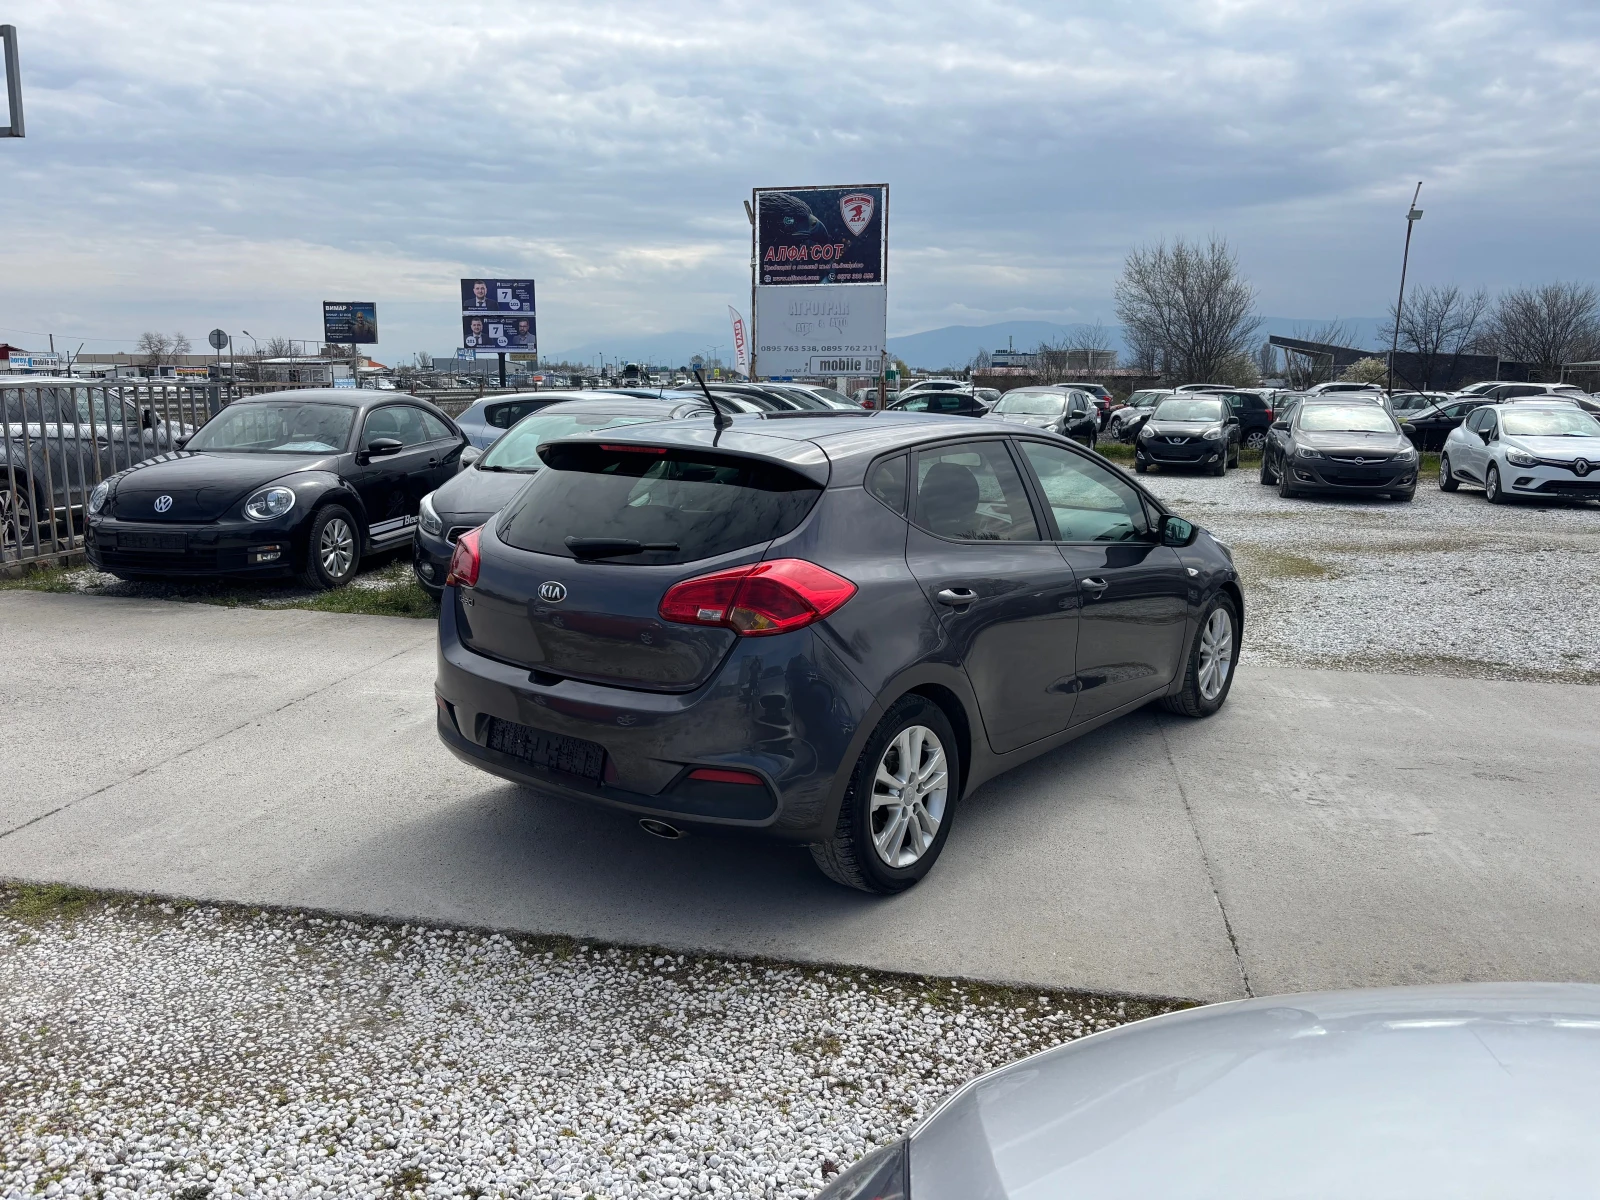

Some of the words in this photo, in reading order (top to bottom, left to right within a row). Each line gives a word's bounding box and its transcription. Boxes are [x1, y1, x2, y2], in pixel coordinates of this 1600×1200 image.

[764, 245, 808, 261] АЛФА
[811, 244, 844, 260] СОТ
[493, 327, 499, 335] 7
[820, 358, 862, 372] mobile
[404, 515, 418, 525] Bee
[541, 585, 561, 599] KIA
